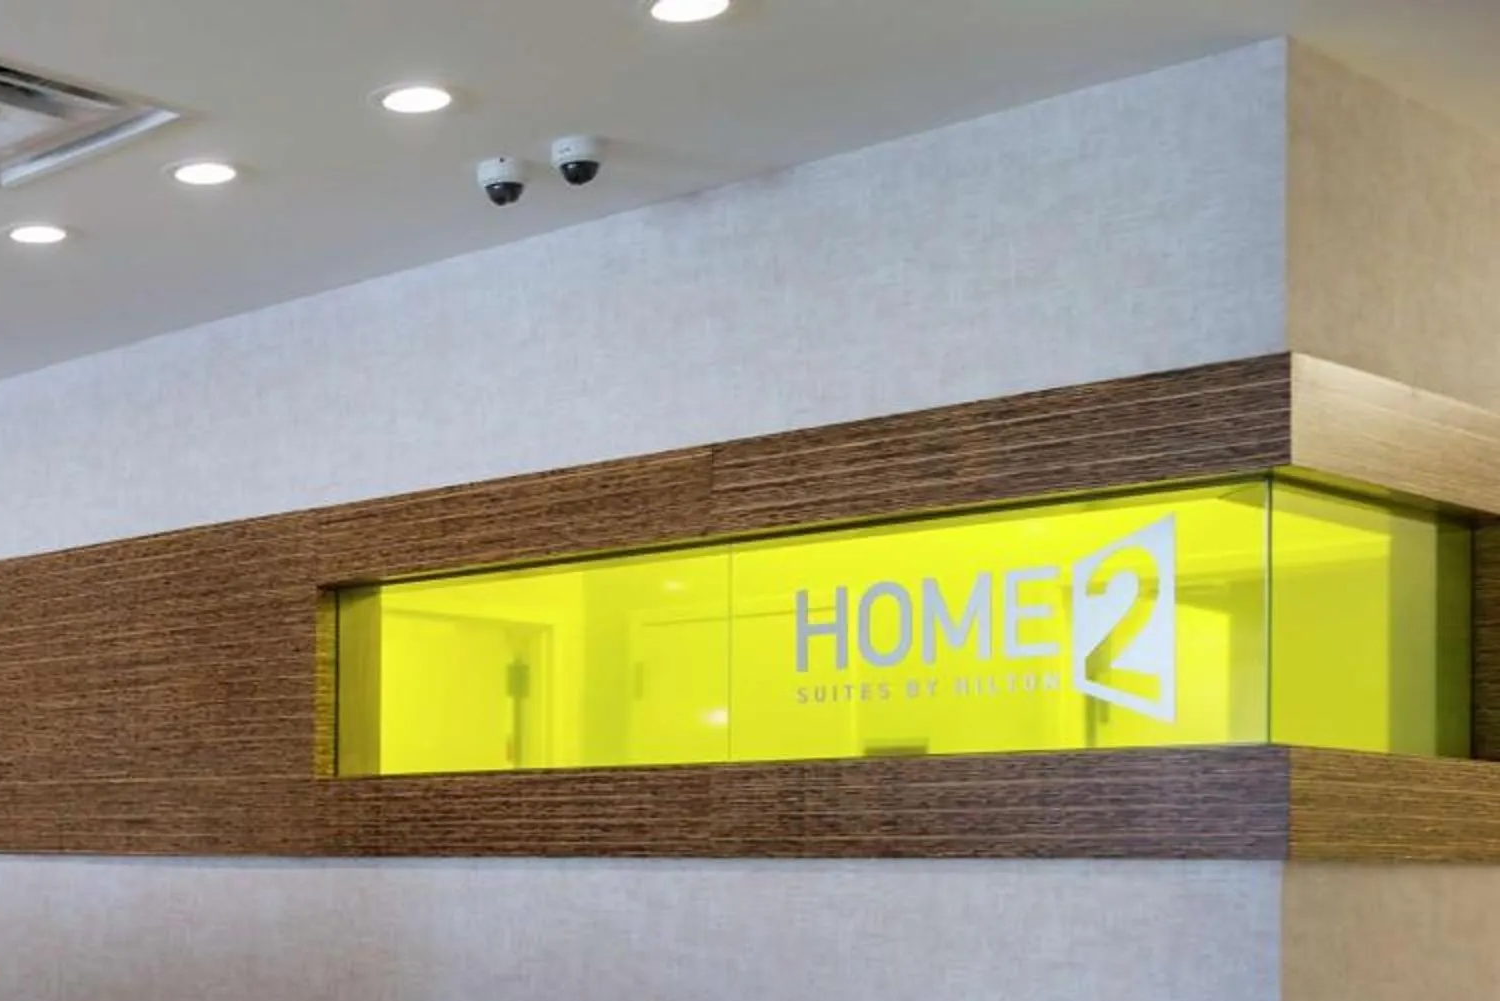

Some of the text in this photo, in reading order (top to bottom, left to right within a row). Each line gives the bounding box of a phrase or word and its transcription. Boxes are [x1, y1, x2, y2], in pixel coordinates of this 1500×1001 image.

[796, 672, 1060, 704] SUITES BY HILTON
